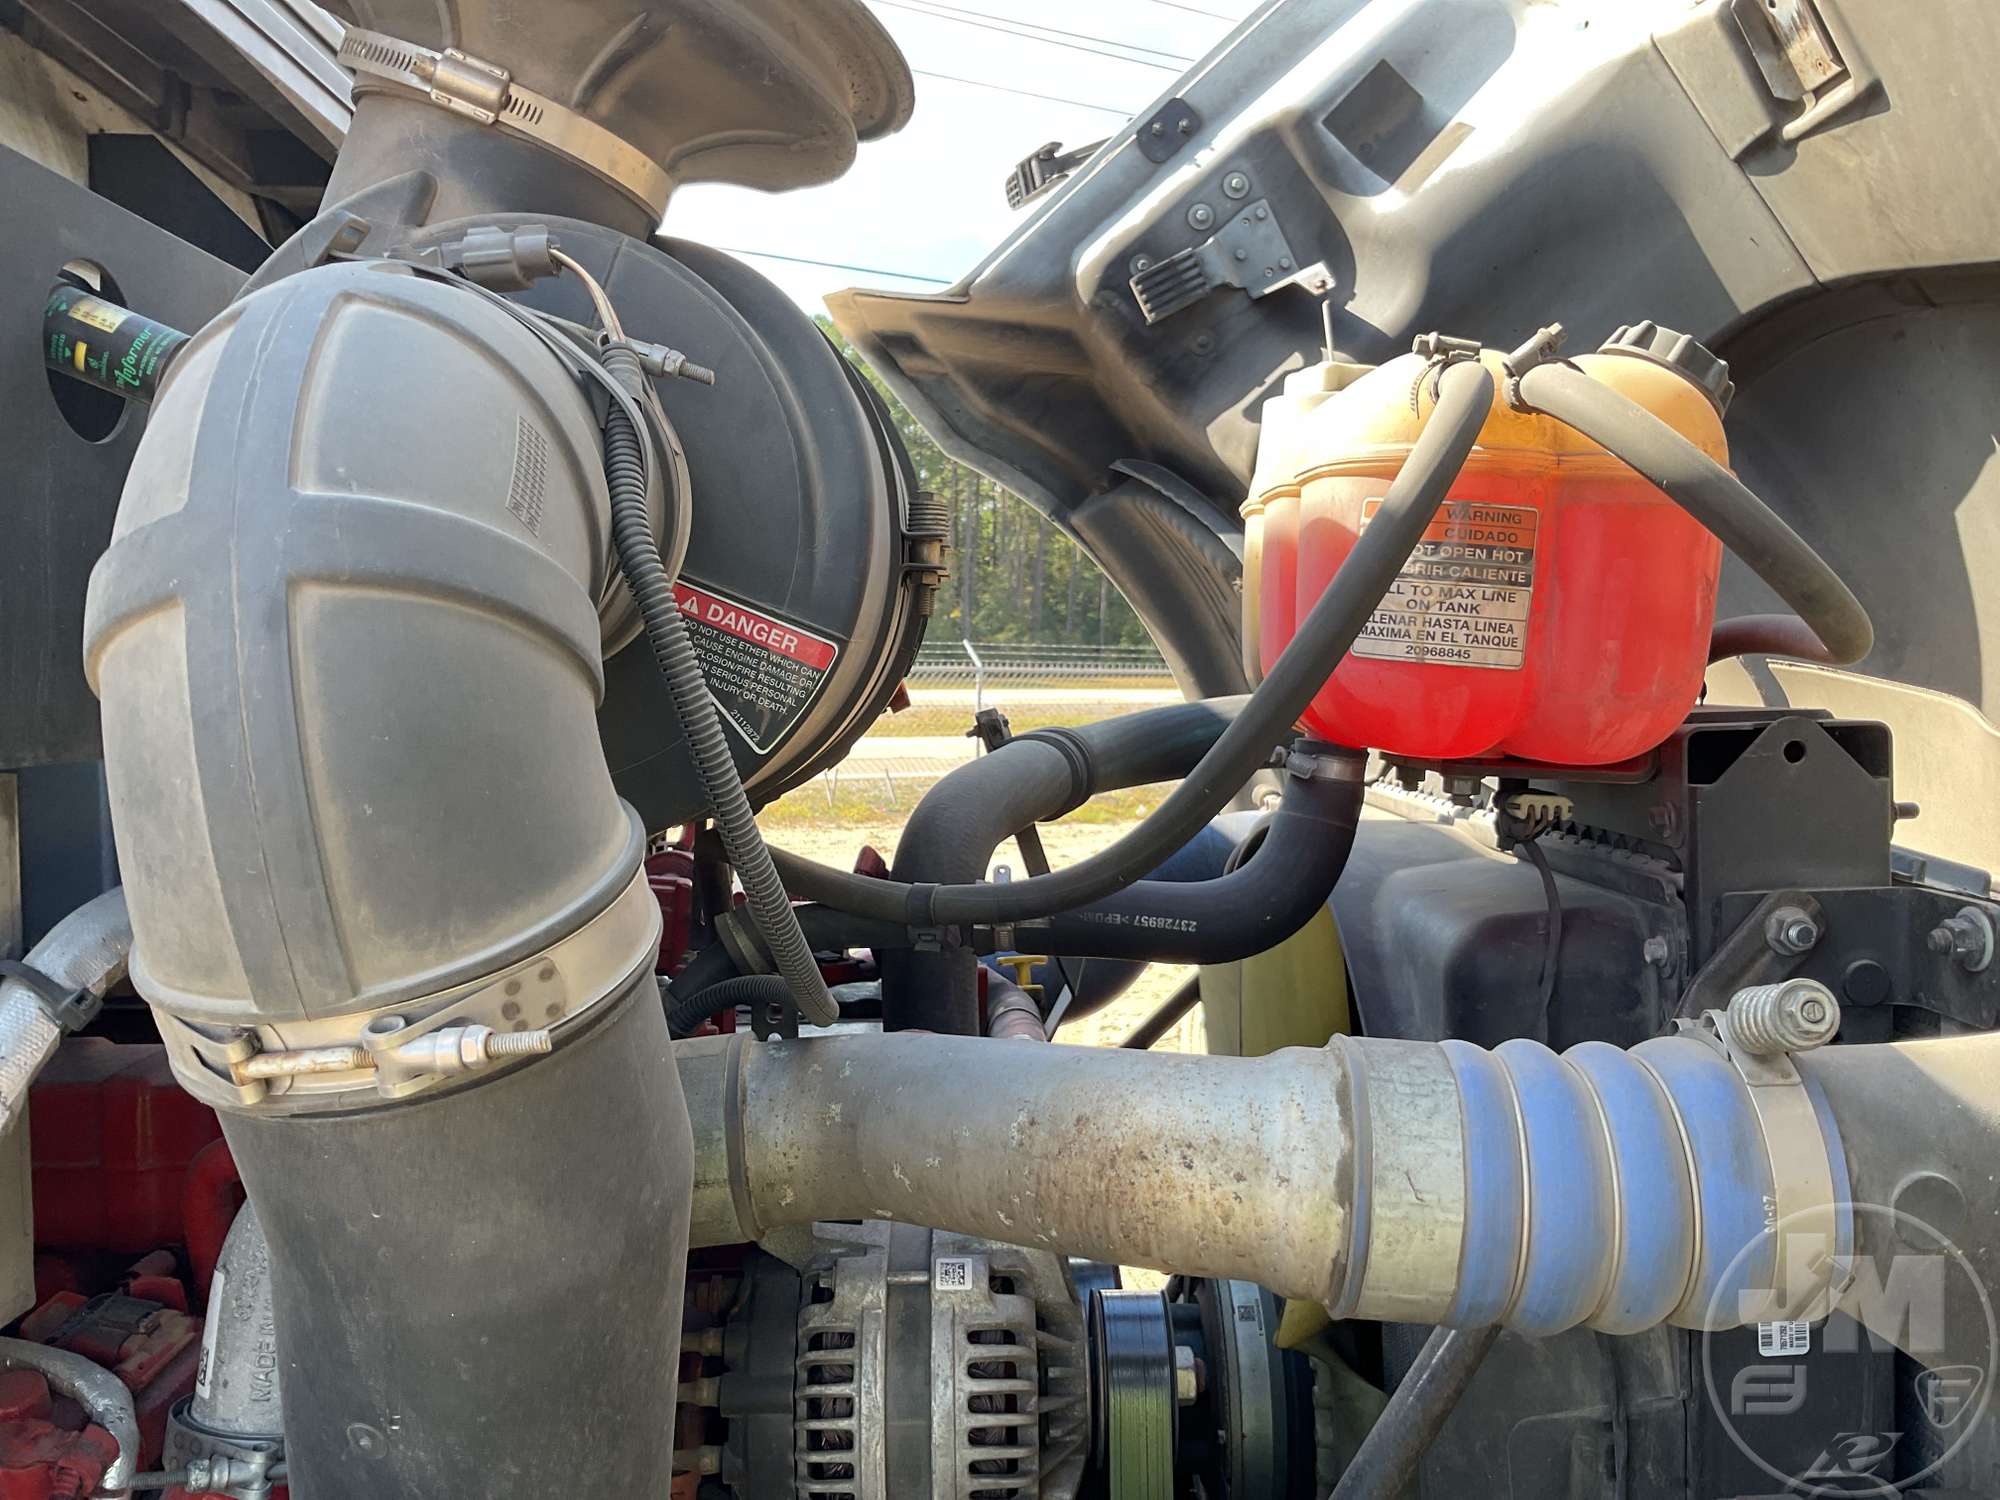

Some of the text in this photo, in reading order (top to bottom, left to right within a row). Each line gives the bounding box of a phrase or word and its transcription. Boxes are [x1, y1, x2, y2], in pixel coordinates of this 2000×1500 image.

[1446, 507, 1522, 525] WARNING
[1444, 527, 1519, 544] CUIDADO
[1413, 543, 1525, 563] OT OPEN HOT
[1403, 562, 1527, 583] BRIR CALIENTE
[1410, 584, 1433, 597] TO
[1438, 586, 1477, 601] MAX
[1481, 589, 1517, 604] LINE
[1406, 598, 1481, 615] ON TANK
[706, 603, 798, 653] DANGER
[1422, 615, 1470, 631] HASTA
[1474, 620, 1515, 635] LINEA
[1360, 625, 1519, 648] MAXIMA EN EL TANQUE
[684, 618, 821, 681] DO NOT USE ETHER WHICH CAN
[693, 634, 724, 654] CAUSE
[725, 647, 759, 668] ENGINE
[759, 661, 799, 684] DAMAGE
[1405, 644, 1472, 660] 20968845
[700, 661, 797, 707] IN SERIOUS PERSONAL
[710, 677, 743, 696] INJURY
[742, 690, 758, 702] OR
[757, 673, 806, 698] RESULTING
[1133, 914, 1197, 933] 23728957
[251, 1338, 276, 1403] MADE
